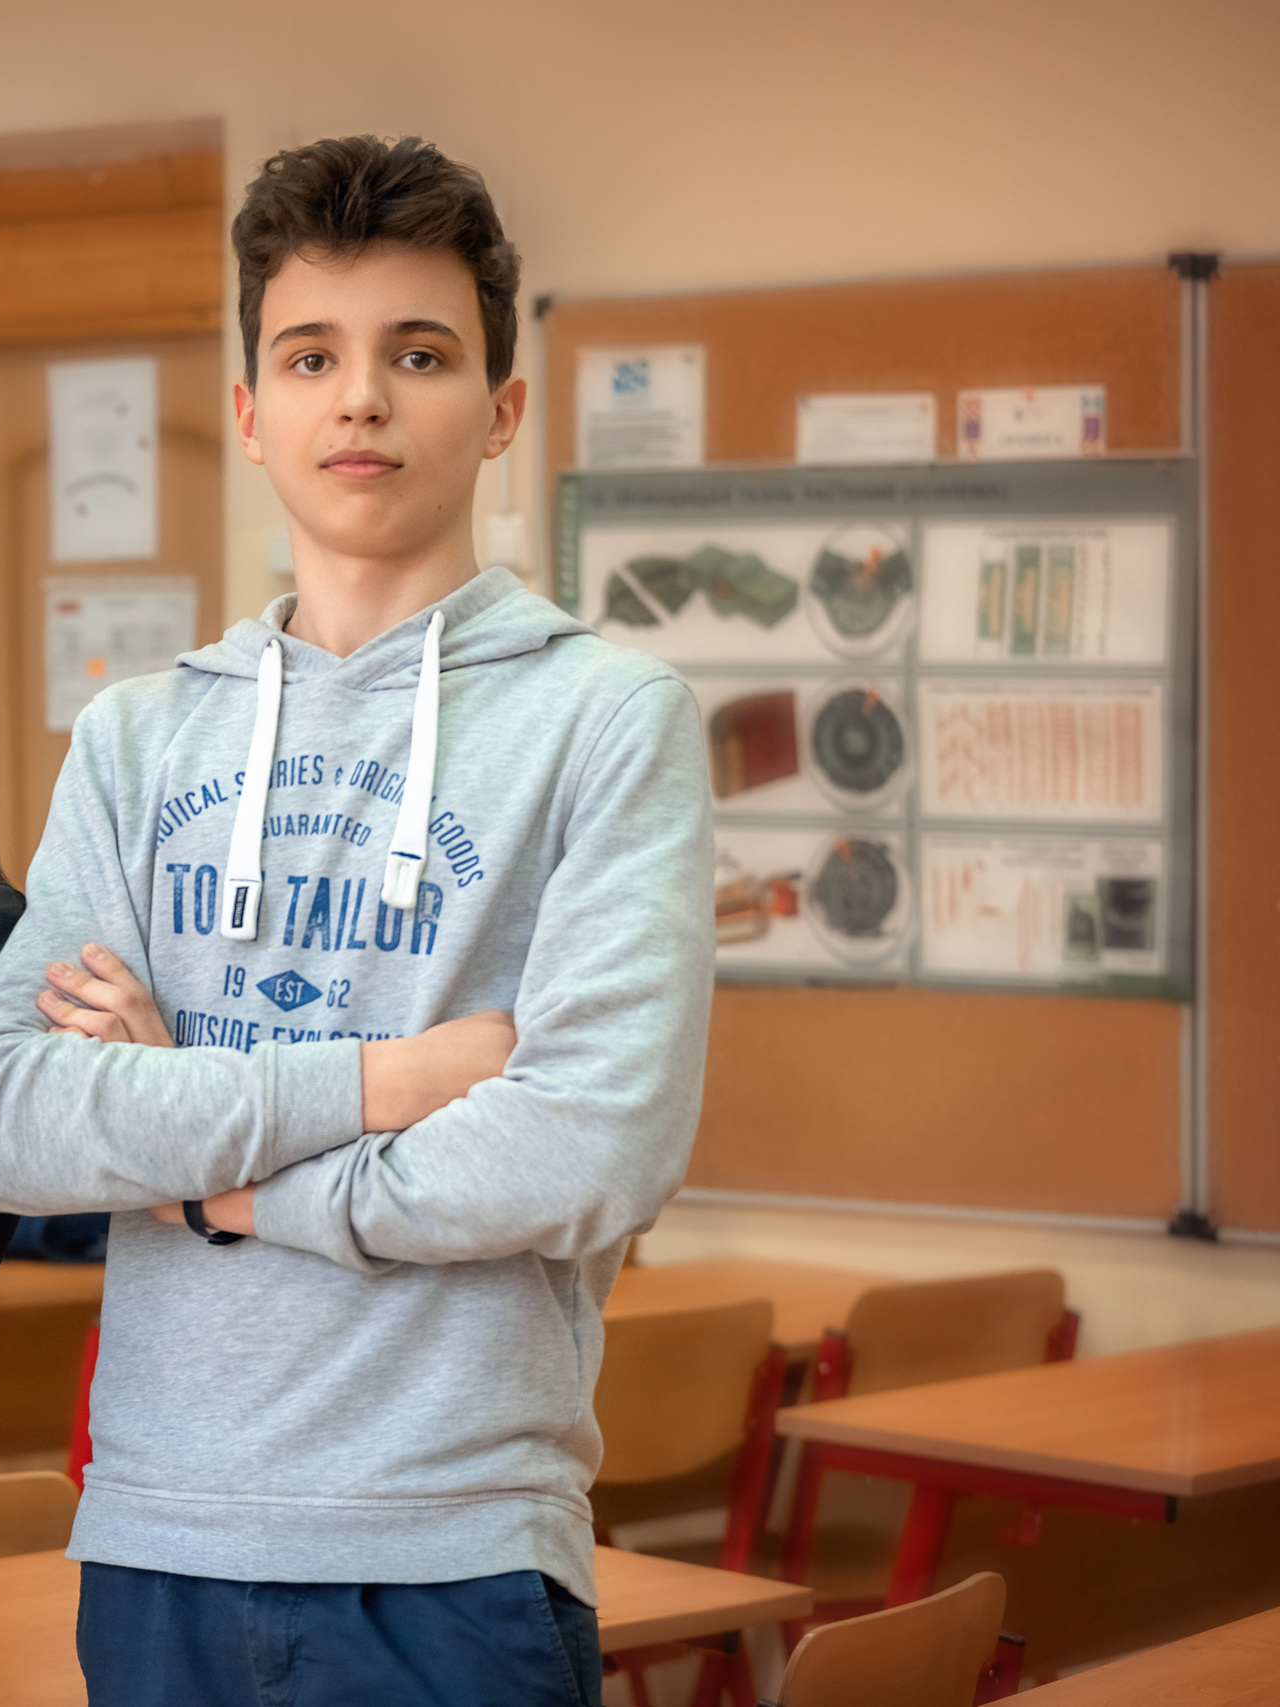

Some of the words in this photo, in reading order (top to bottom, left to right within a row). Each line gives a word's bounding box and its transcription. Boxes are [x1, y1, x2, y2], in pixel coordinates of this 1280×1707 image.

[157, 778, 228, 850] UTICAL
[234, 754, 324, 797] SRIES
[349, 759, 437, 806] ORIGI
[428, 811, 484, 888] GOODS
[166, 863, 265, 942] TO
[282, 875, 444, 956] TAILOR
[223, 964, 246, 998] 19
[273, 977, 304, 1004] EST
[326, 979, 351, 1008] 62
